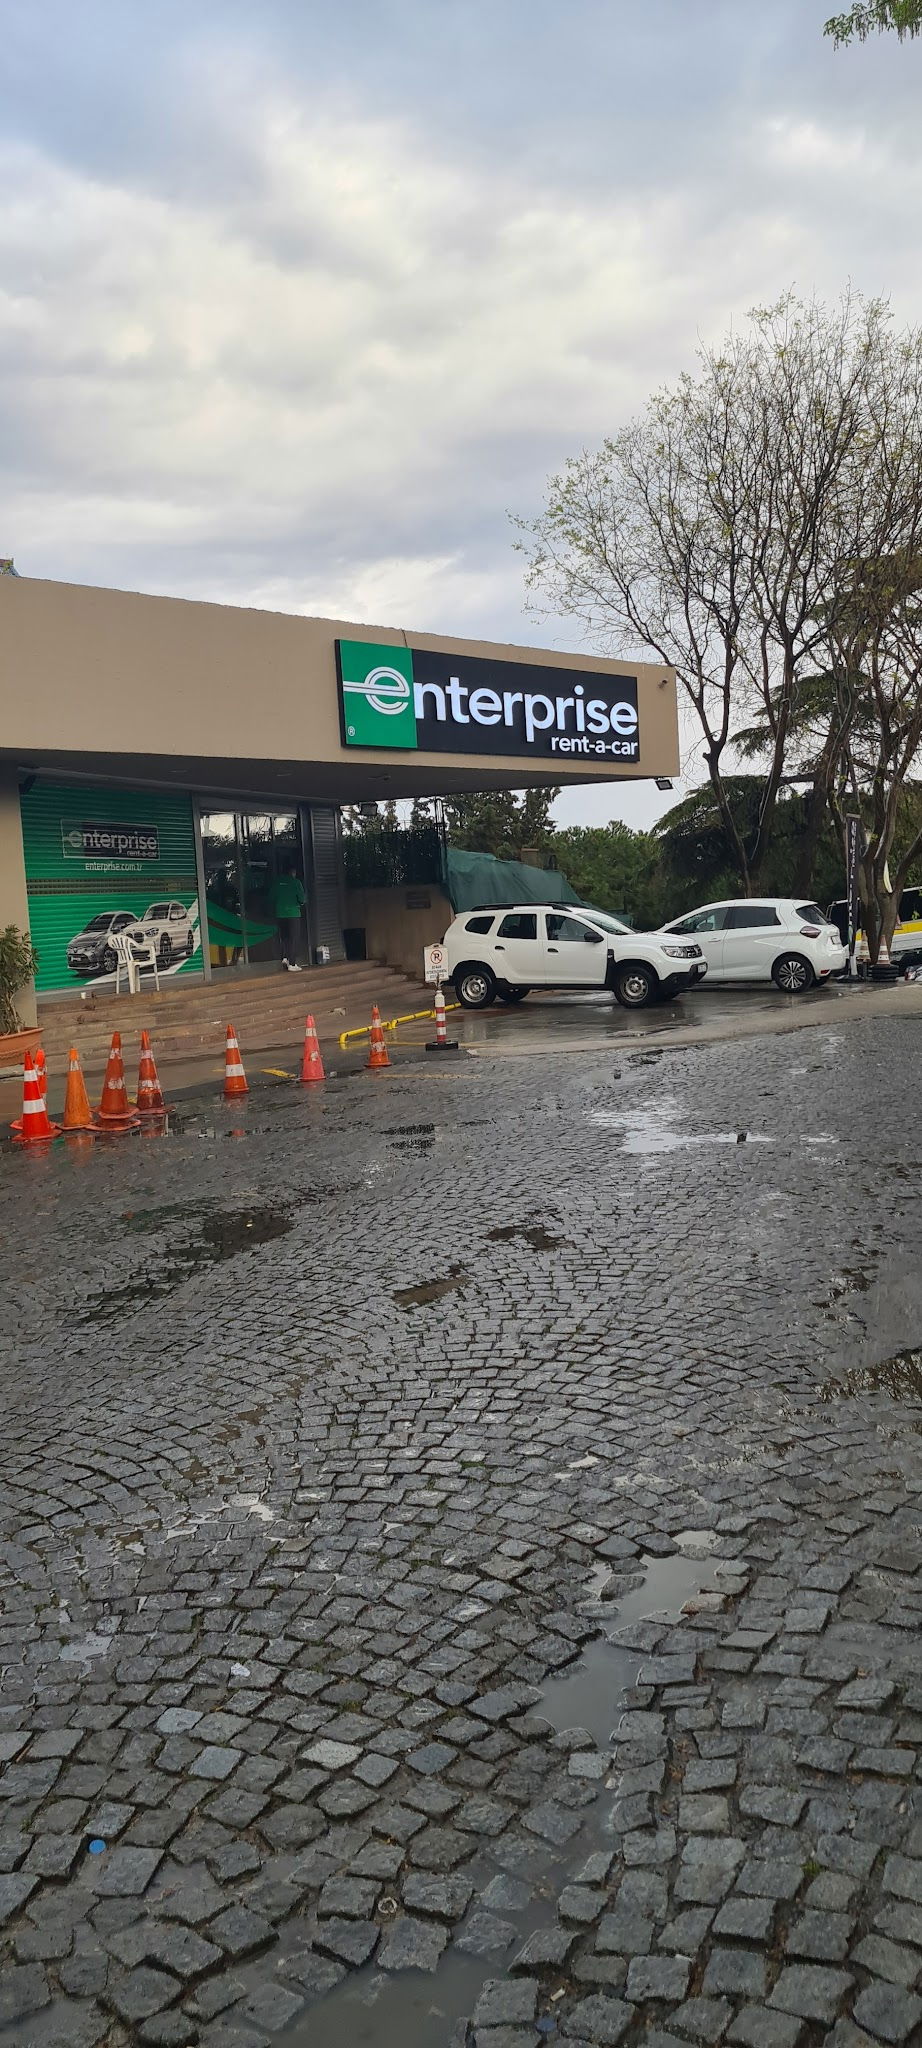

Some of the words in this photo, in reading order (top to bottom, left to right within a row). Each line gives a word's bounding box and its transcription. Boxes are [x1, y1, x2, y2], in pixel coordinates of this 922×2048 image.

[343, 666, 637, 743] enterprise
[551, 734, 638, 756] rent-a-car
[63, 830, 157, 853] enterprise
[85, 861, 142, 872] enterprise.com.tr
